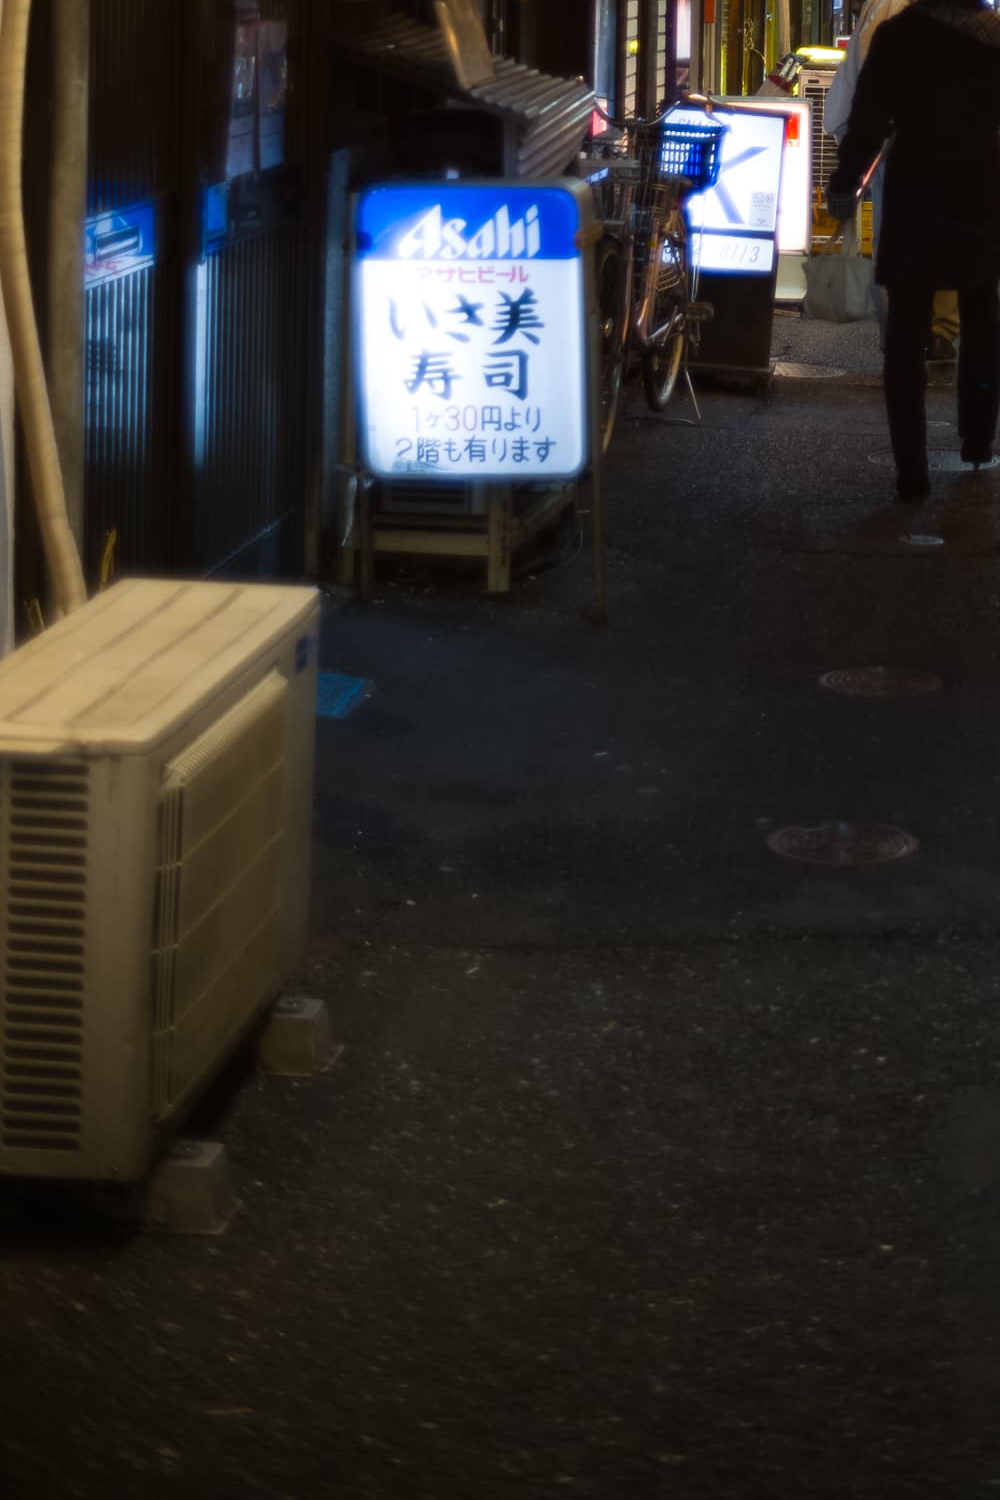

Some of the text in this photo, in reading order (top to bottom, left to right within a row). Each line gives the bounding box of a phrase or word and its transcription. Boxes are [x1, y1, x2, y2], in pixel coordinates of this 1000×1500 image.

[399, 202, 542, 259] Asahi
[417, 265, 530, 285] アサヒビール
[388, 287, 546, 346] いさ美
[402, 348, 532, 402] 寿司
